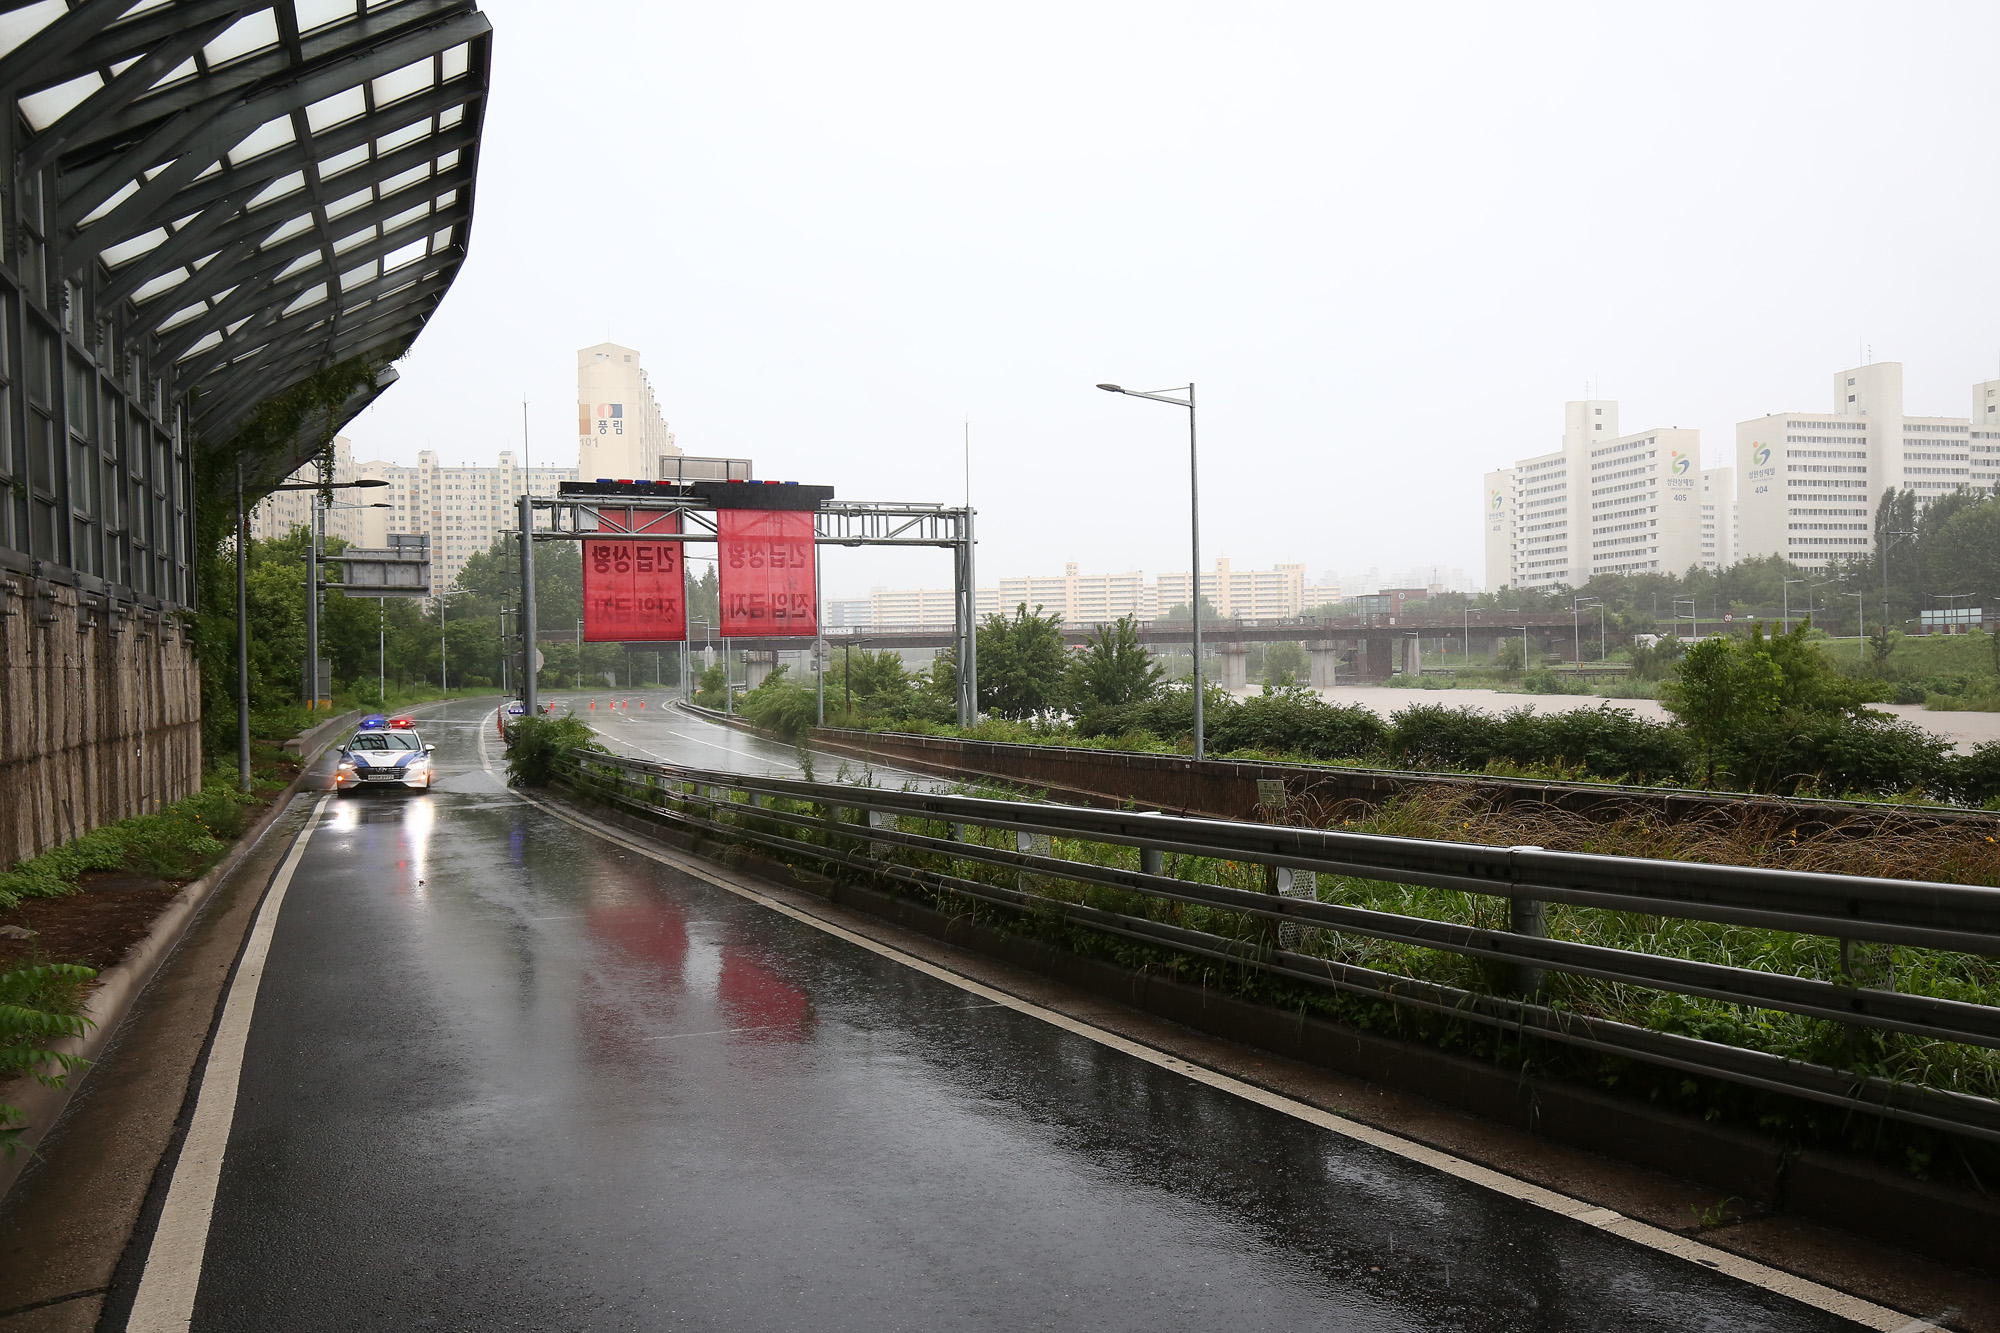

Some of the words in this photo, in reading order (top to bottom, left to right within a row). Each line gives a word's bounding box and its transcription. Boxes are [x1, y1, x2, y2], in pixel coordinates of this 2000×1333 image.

[580, 437, 599, 448] 101
[1755, 485, 1768, 494] 404
[1673, 494, 1687, 502] 405
